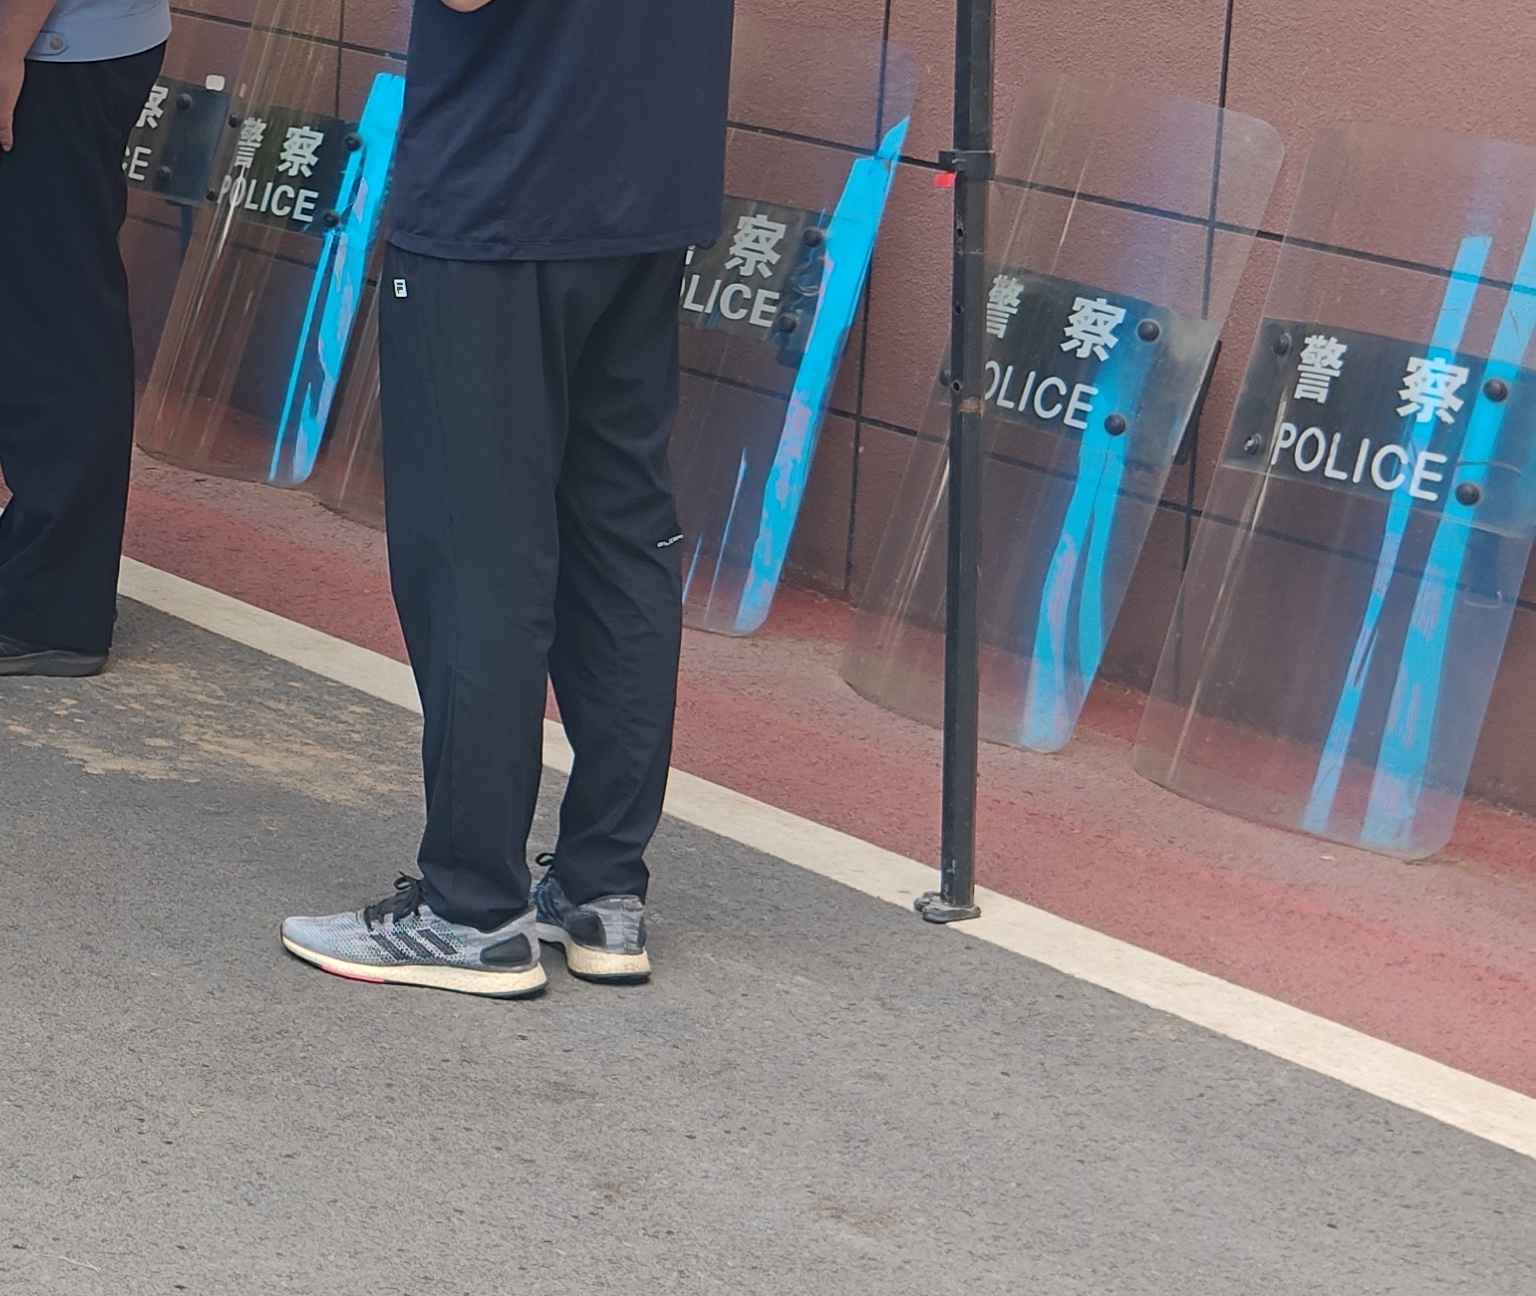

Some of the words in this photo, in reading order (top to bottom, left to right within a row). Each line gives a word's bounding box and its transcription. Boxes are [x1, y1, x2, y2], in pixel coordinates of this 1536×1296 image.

[135, 83, 169, 129] 察
[234, 116, 325, 179] 警察
[216, 174, 320, 223] POLICE
[680, 274, 781, 328] LICE
[985, 274, 1127, 362] 警察
[984, 360, 1099, 430] OLICE
[1293, 334, 1470, 425] 警察
[1271, 421, 1448, 502] POLICE
